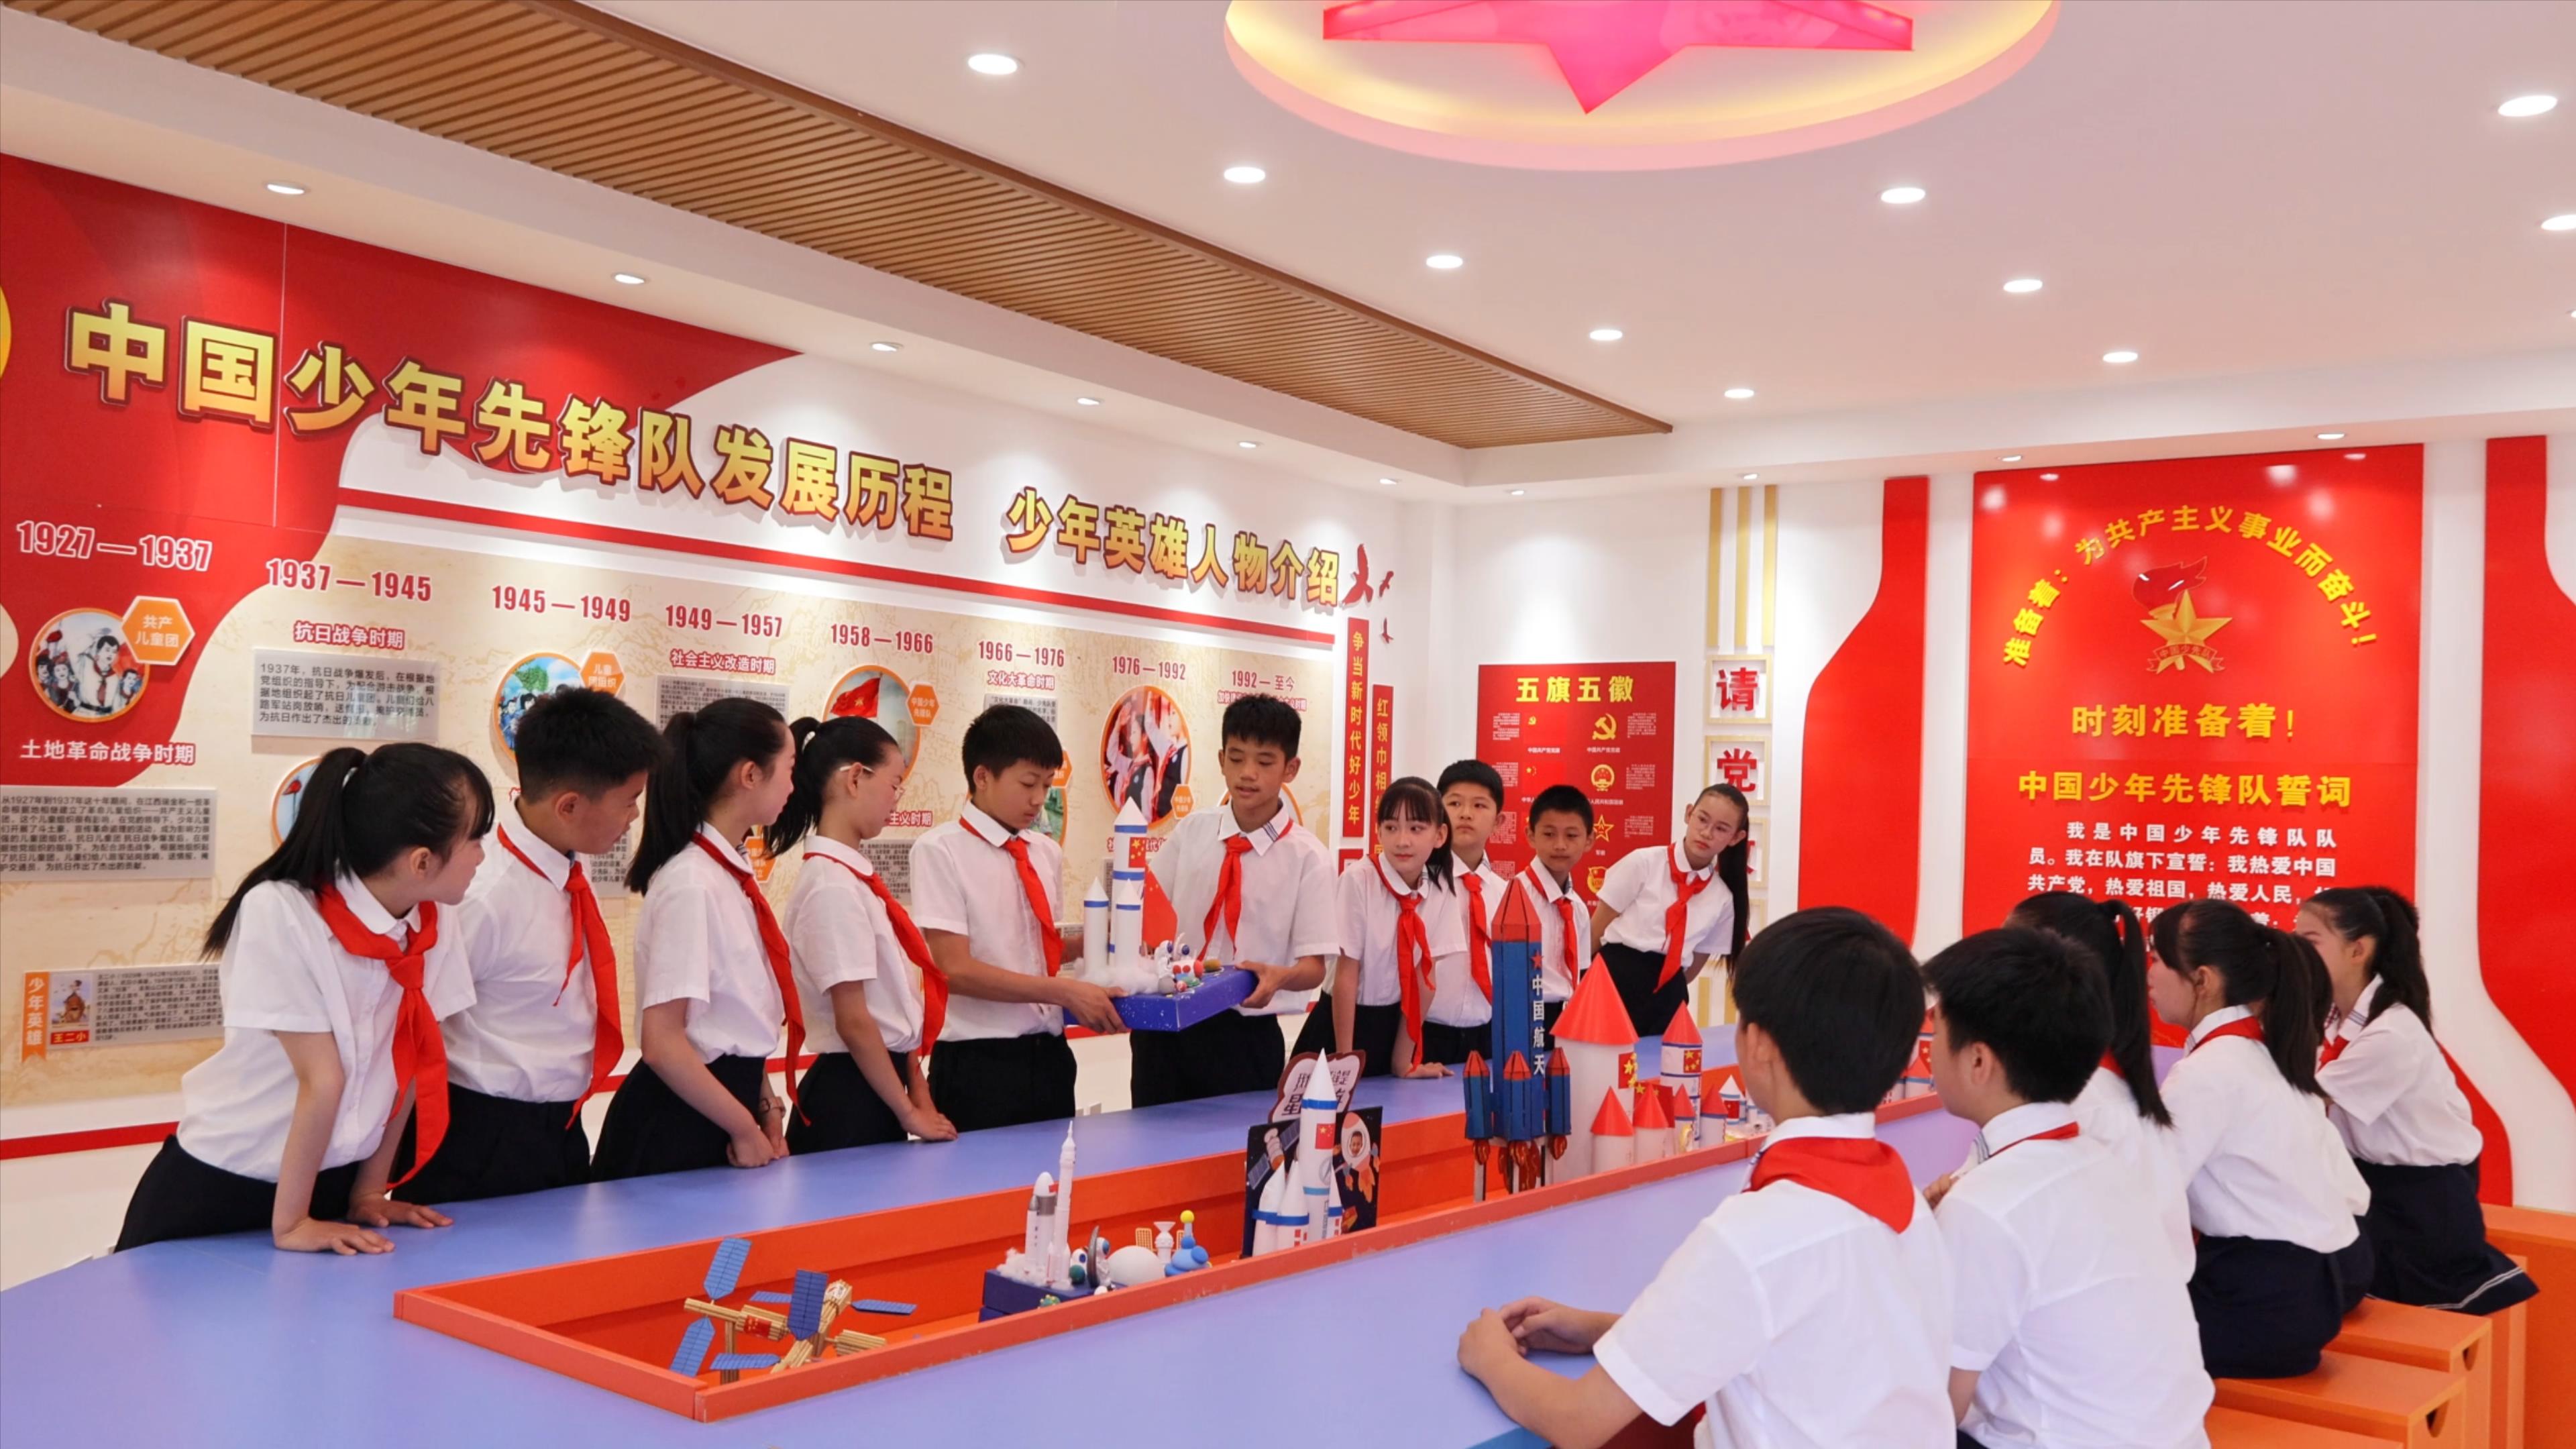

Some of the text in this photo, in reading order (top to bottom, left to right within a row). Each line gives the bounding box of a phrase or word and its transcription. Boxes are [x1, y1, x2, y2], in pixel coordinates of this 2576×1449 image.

[65, 298, 1340, 607] 中国少年先锋队发展历程 少年英雄人物介绍
[142, 613, 172, 629] 共产
[135, 631, 179, 649] 儿童团
[294, 622, 404, 649] 抗日战争时期
[672, 650, 775, 674] 社会主义改造时期
[988, 671, 1055, 690] 文化大革命时期
[1516, 676, 1633, 703] 五旗五徽
[1348, 631, 1364, 825] 争当新时代好少年
[20, 739, 195, 764] 土地革命战争时期
[2019, 771, 2352, 808] 中国少年先锋队誓词
[890, 811, 933, 826] 主义时期
[2066, 822, 2337, 848] 我是中国少年先锋队队
[26, 977, 45, 1046] 少年英雄
[53, 1032, 87, 1044] 王二小
[1532, 974, 1546, 1077] 中国航天
